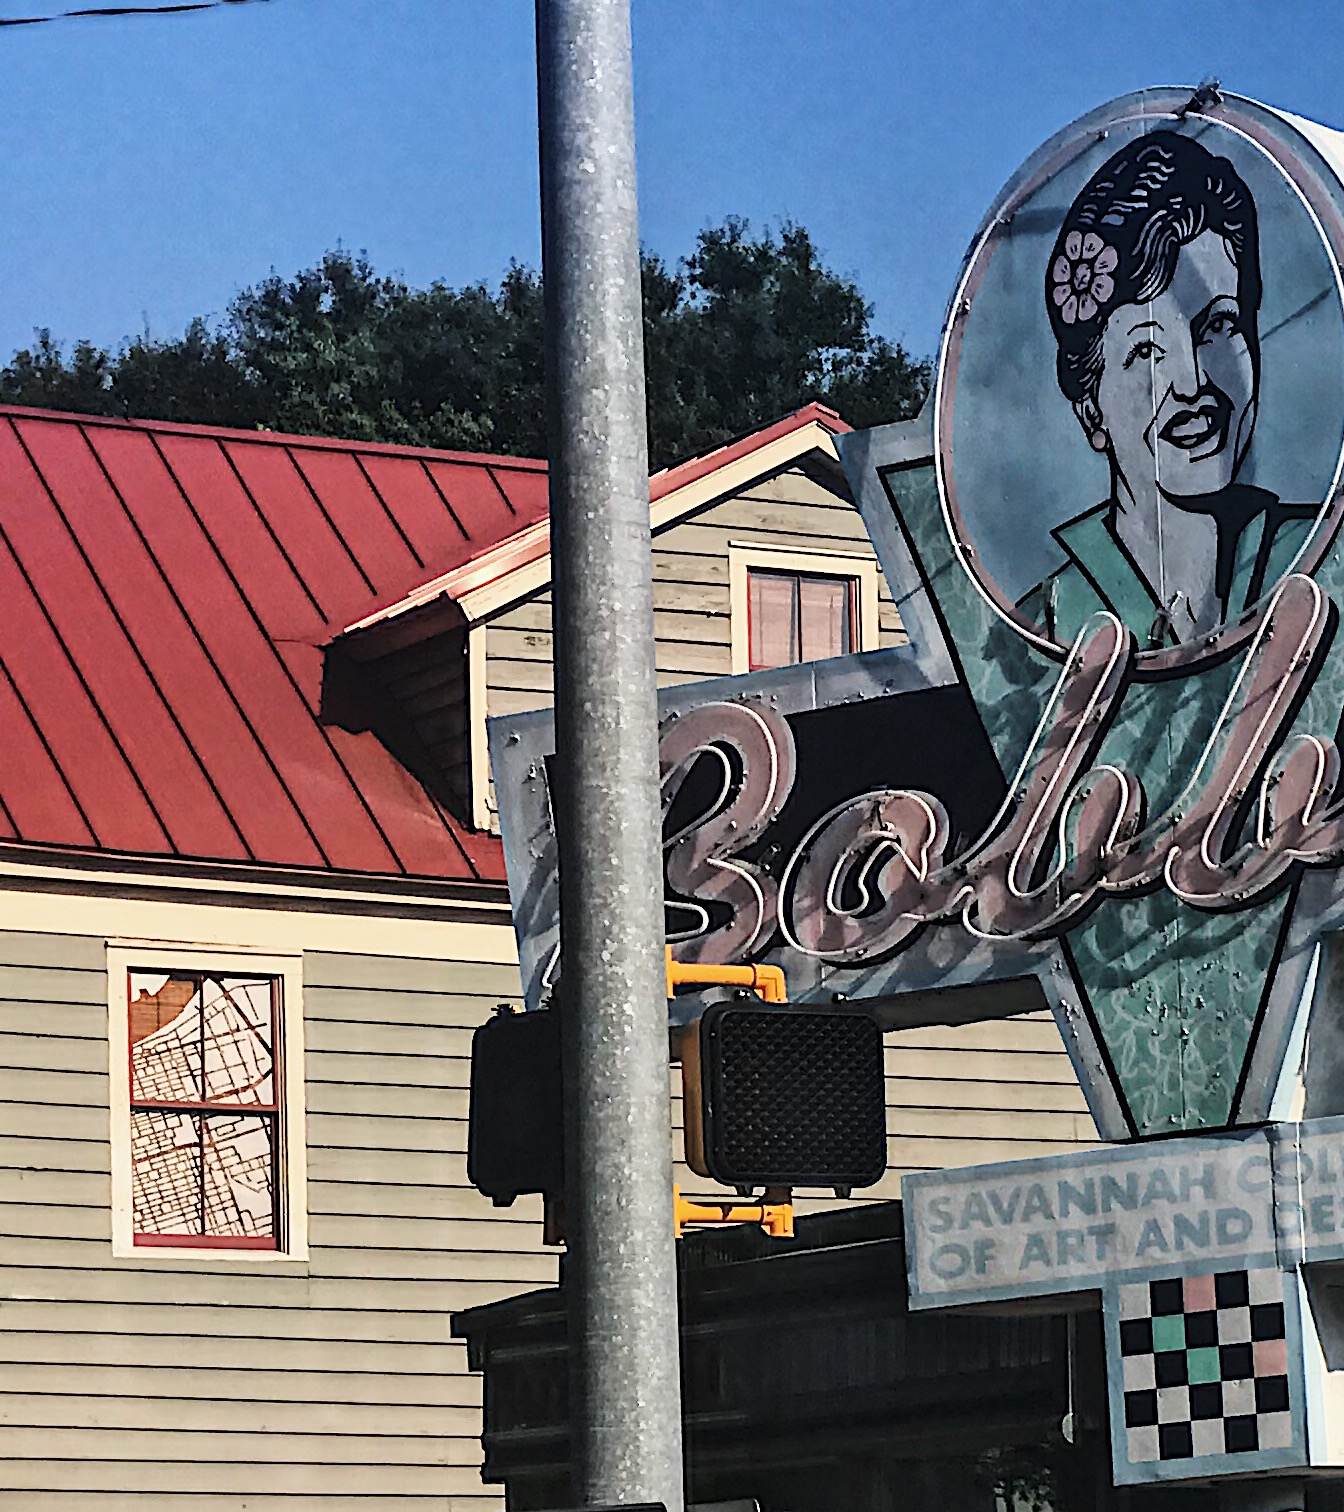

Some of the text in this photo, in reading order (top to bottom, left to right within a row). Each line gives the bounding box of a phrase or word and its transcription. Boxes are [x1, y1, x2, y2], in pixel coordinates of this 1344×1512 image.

[928, 1163, 1216, 1235] SAVANNAH
[928, 1237, 996, 1281] OF
[1018, 1222, 1118, 1271] ART
[1135, 1205, 1254, 1258] AND
